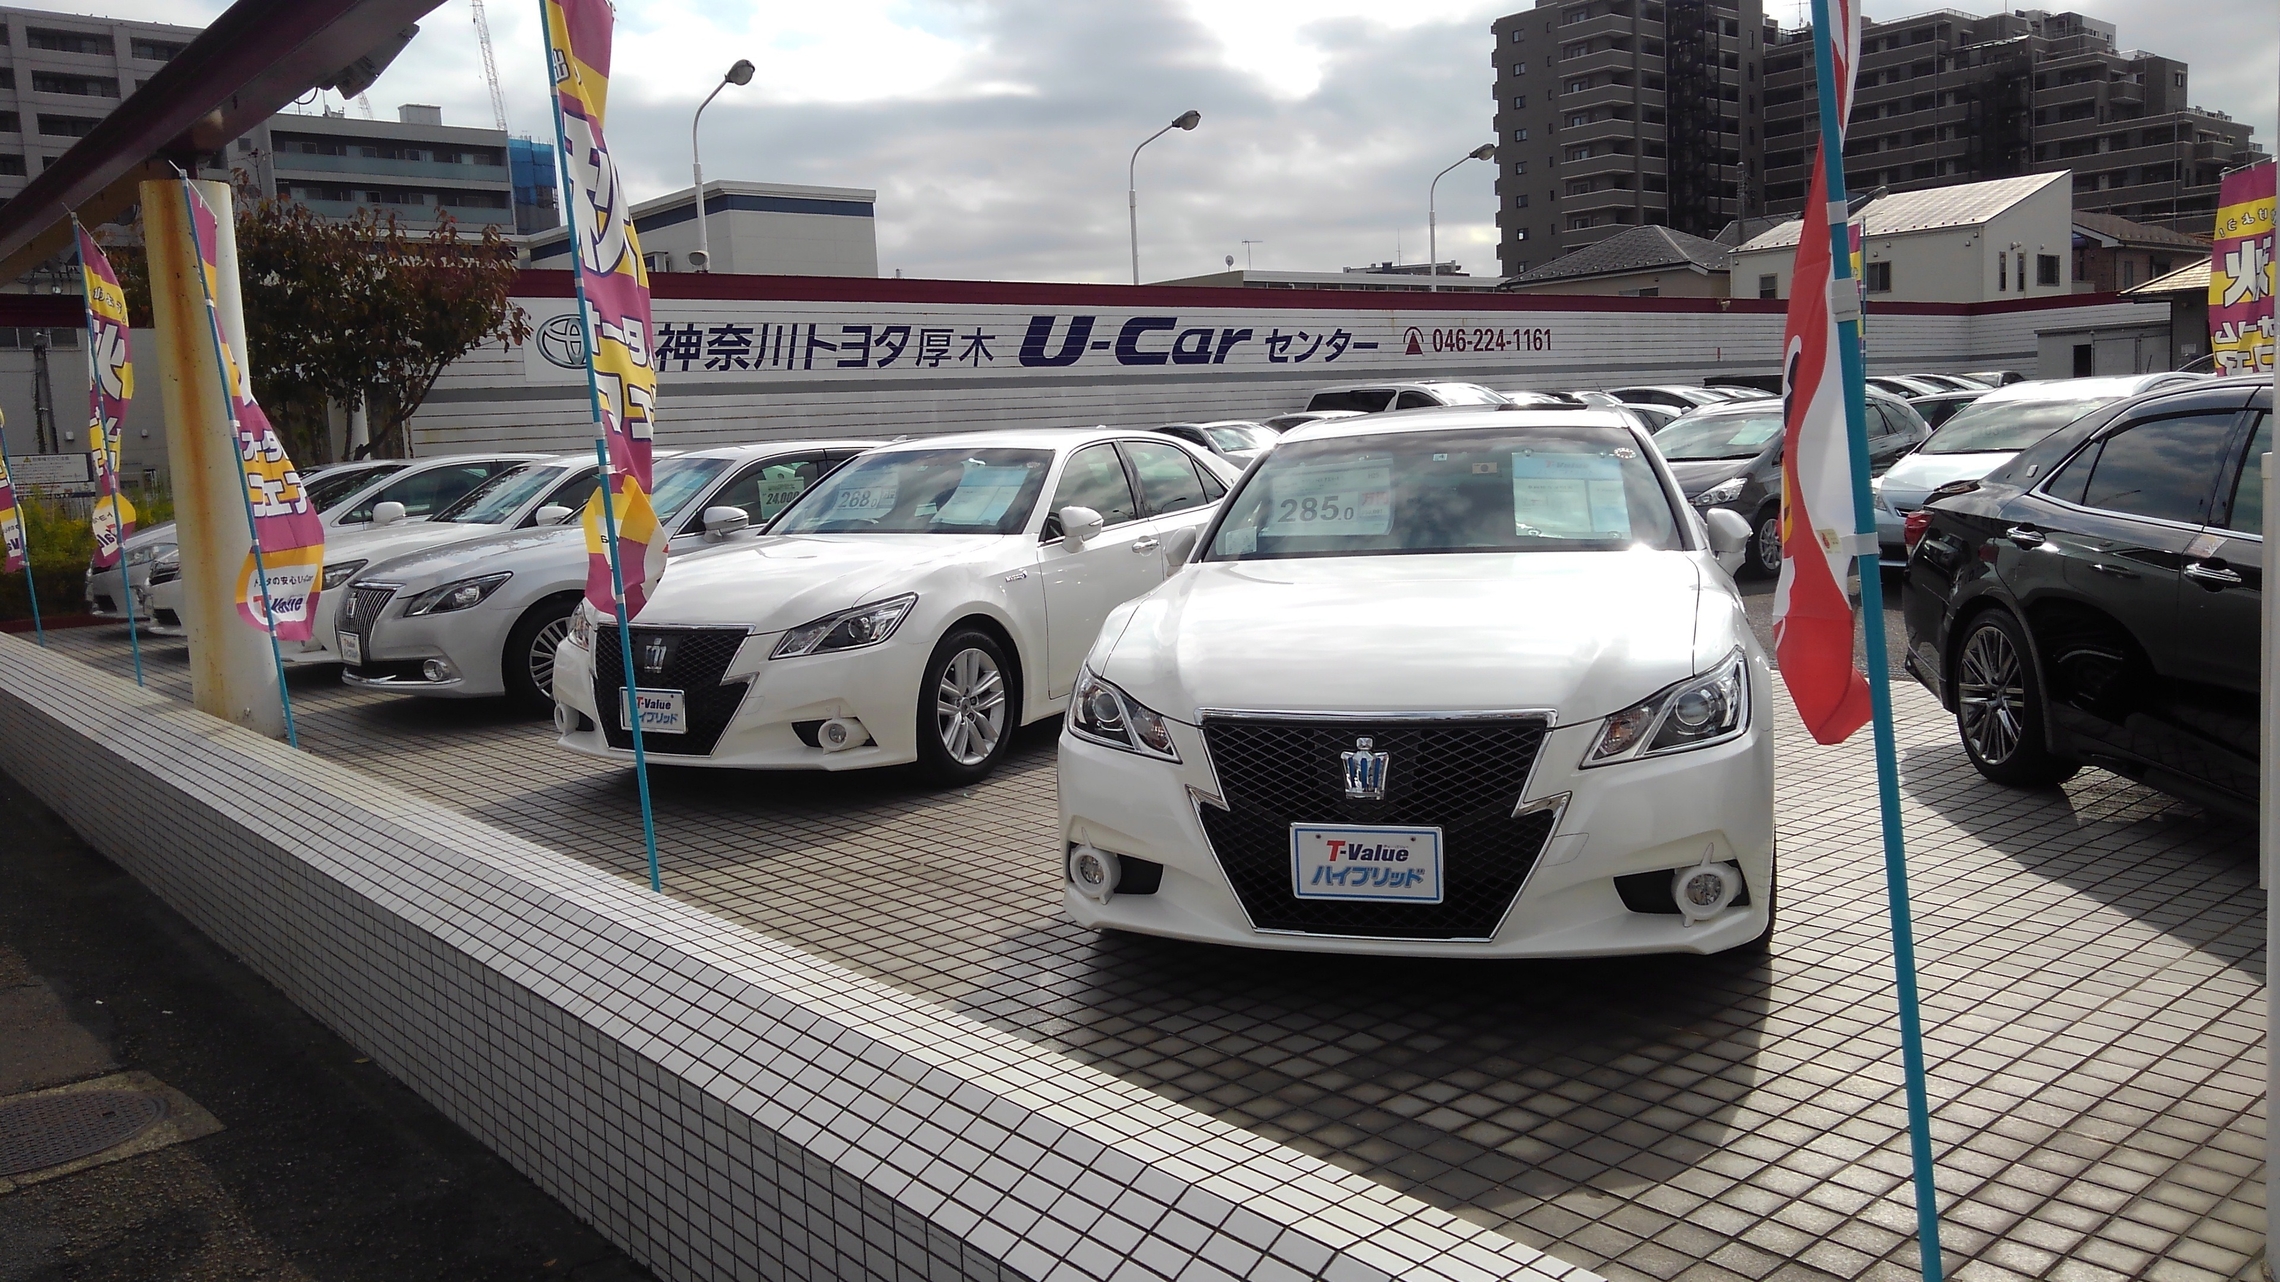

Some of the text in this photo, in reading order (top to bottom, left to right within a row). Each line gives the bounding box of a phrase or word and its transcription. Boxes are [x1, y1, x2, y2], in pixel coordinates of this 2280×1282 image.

[1018, 316, 1252, 368] U-Car
[1264, 327, 1379, 364] センター
[1431, 328, 1553, 353] 046-224-1161
[593, 370, 656, 442] フェ
[1277, 495, 1355, 523] 285.0
[253, 574, 314, 588] トタの安心U-Car
[638, 711, 679, 725] イブリッド
[1326, 840, 1409, 862] T-Value
[1310, 865, 1426, 889] ハイブリッド
